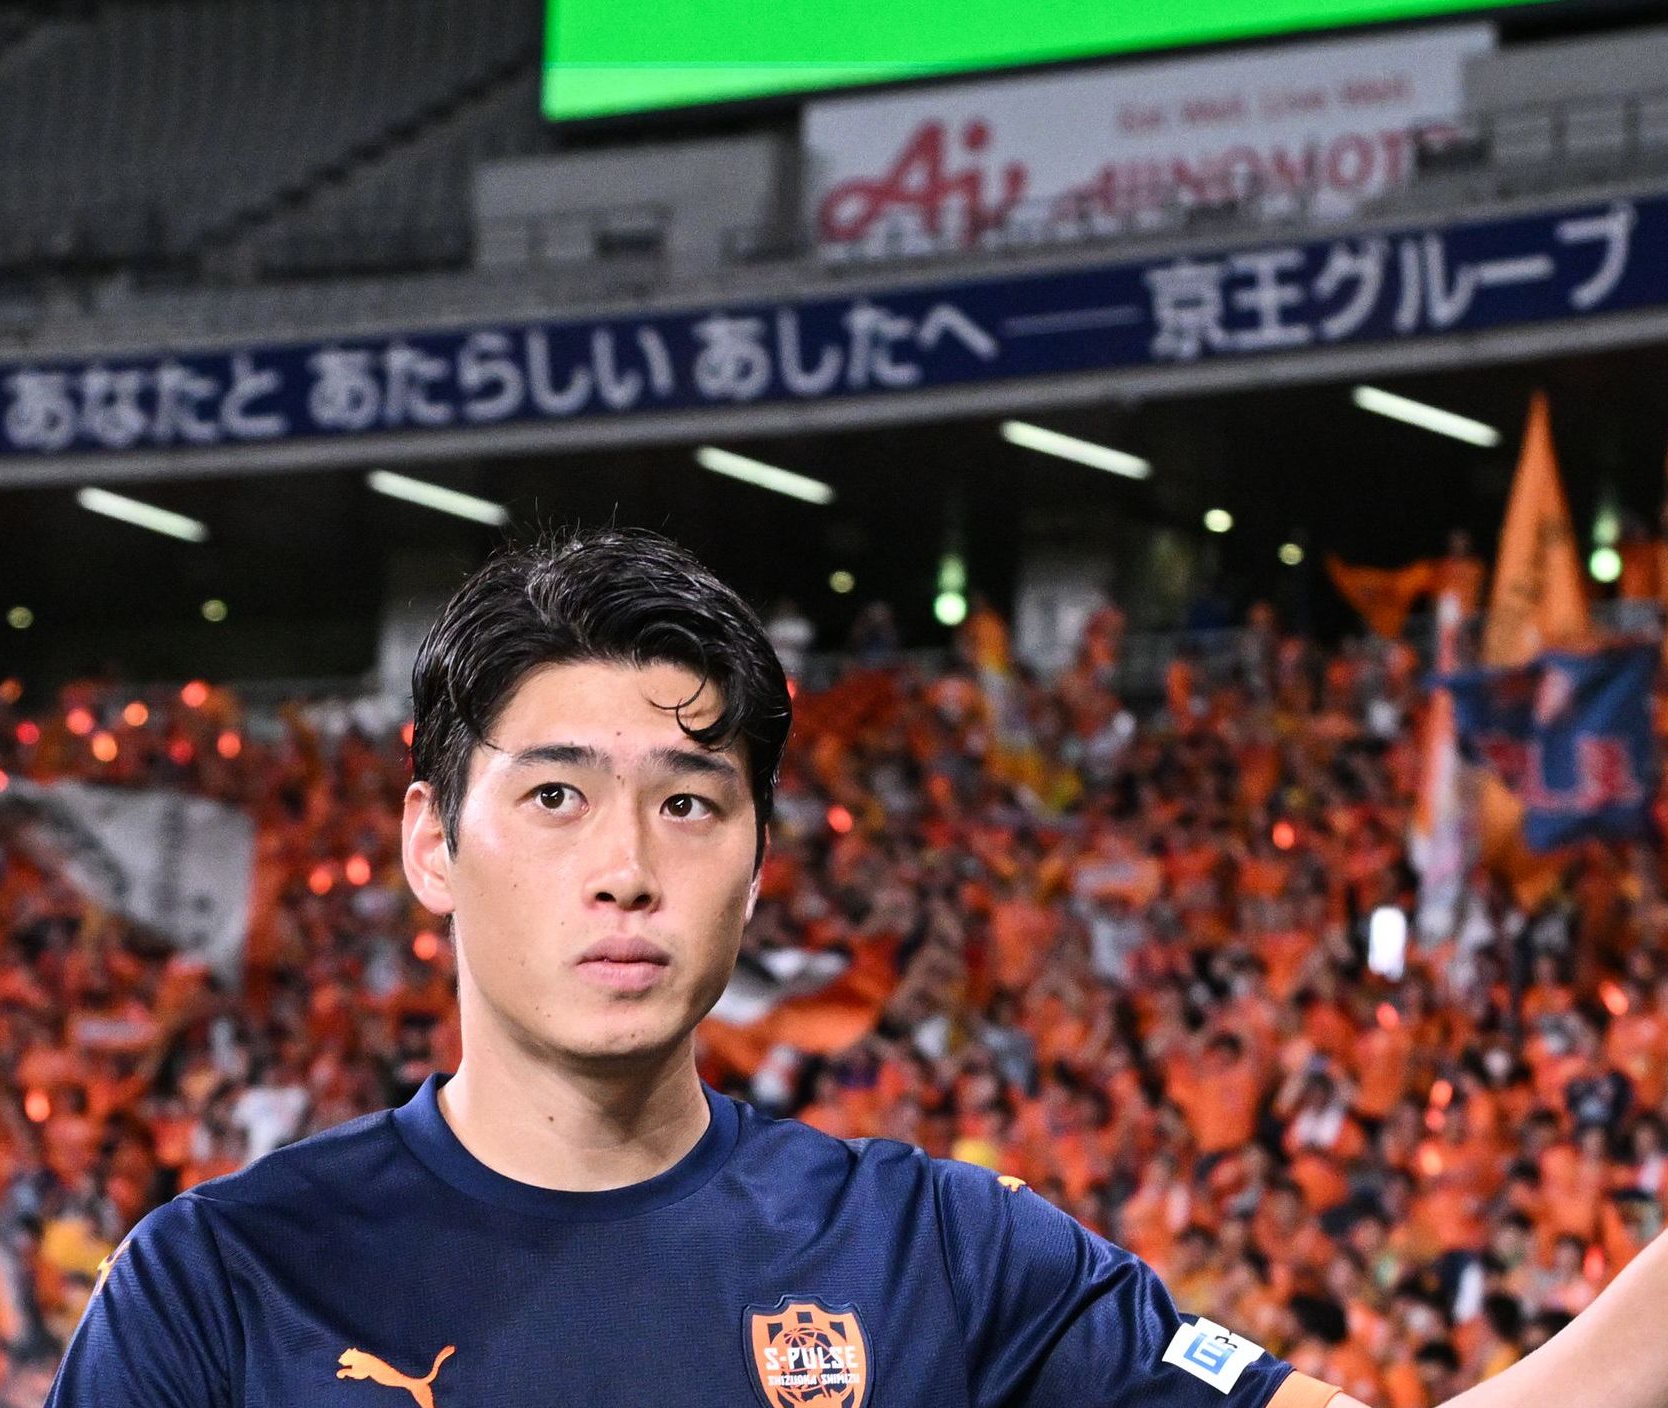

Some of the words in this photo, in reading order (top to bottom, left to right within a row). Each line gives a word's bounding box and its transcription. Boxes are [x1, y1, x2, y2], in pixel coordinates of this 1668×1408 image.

[4, 358, 290, 454] あなたと
[308, 330, 674, 430] あたらしい
[693, 303, 996, 402] あしたへ
[1142, 205, 1638, 360] 京王グループ
[764, 1346, 859, 1371] S-PULSE
[821, 1372, 861, 1385] SHIMIZU
